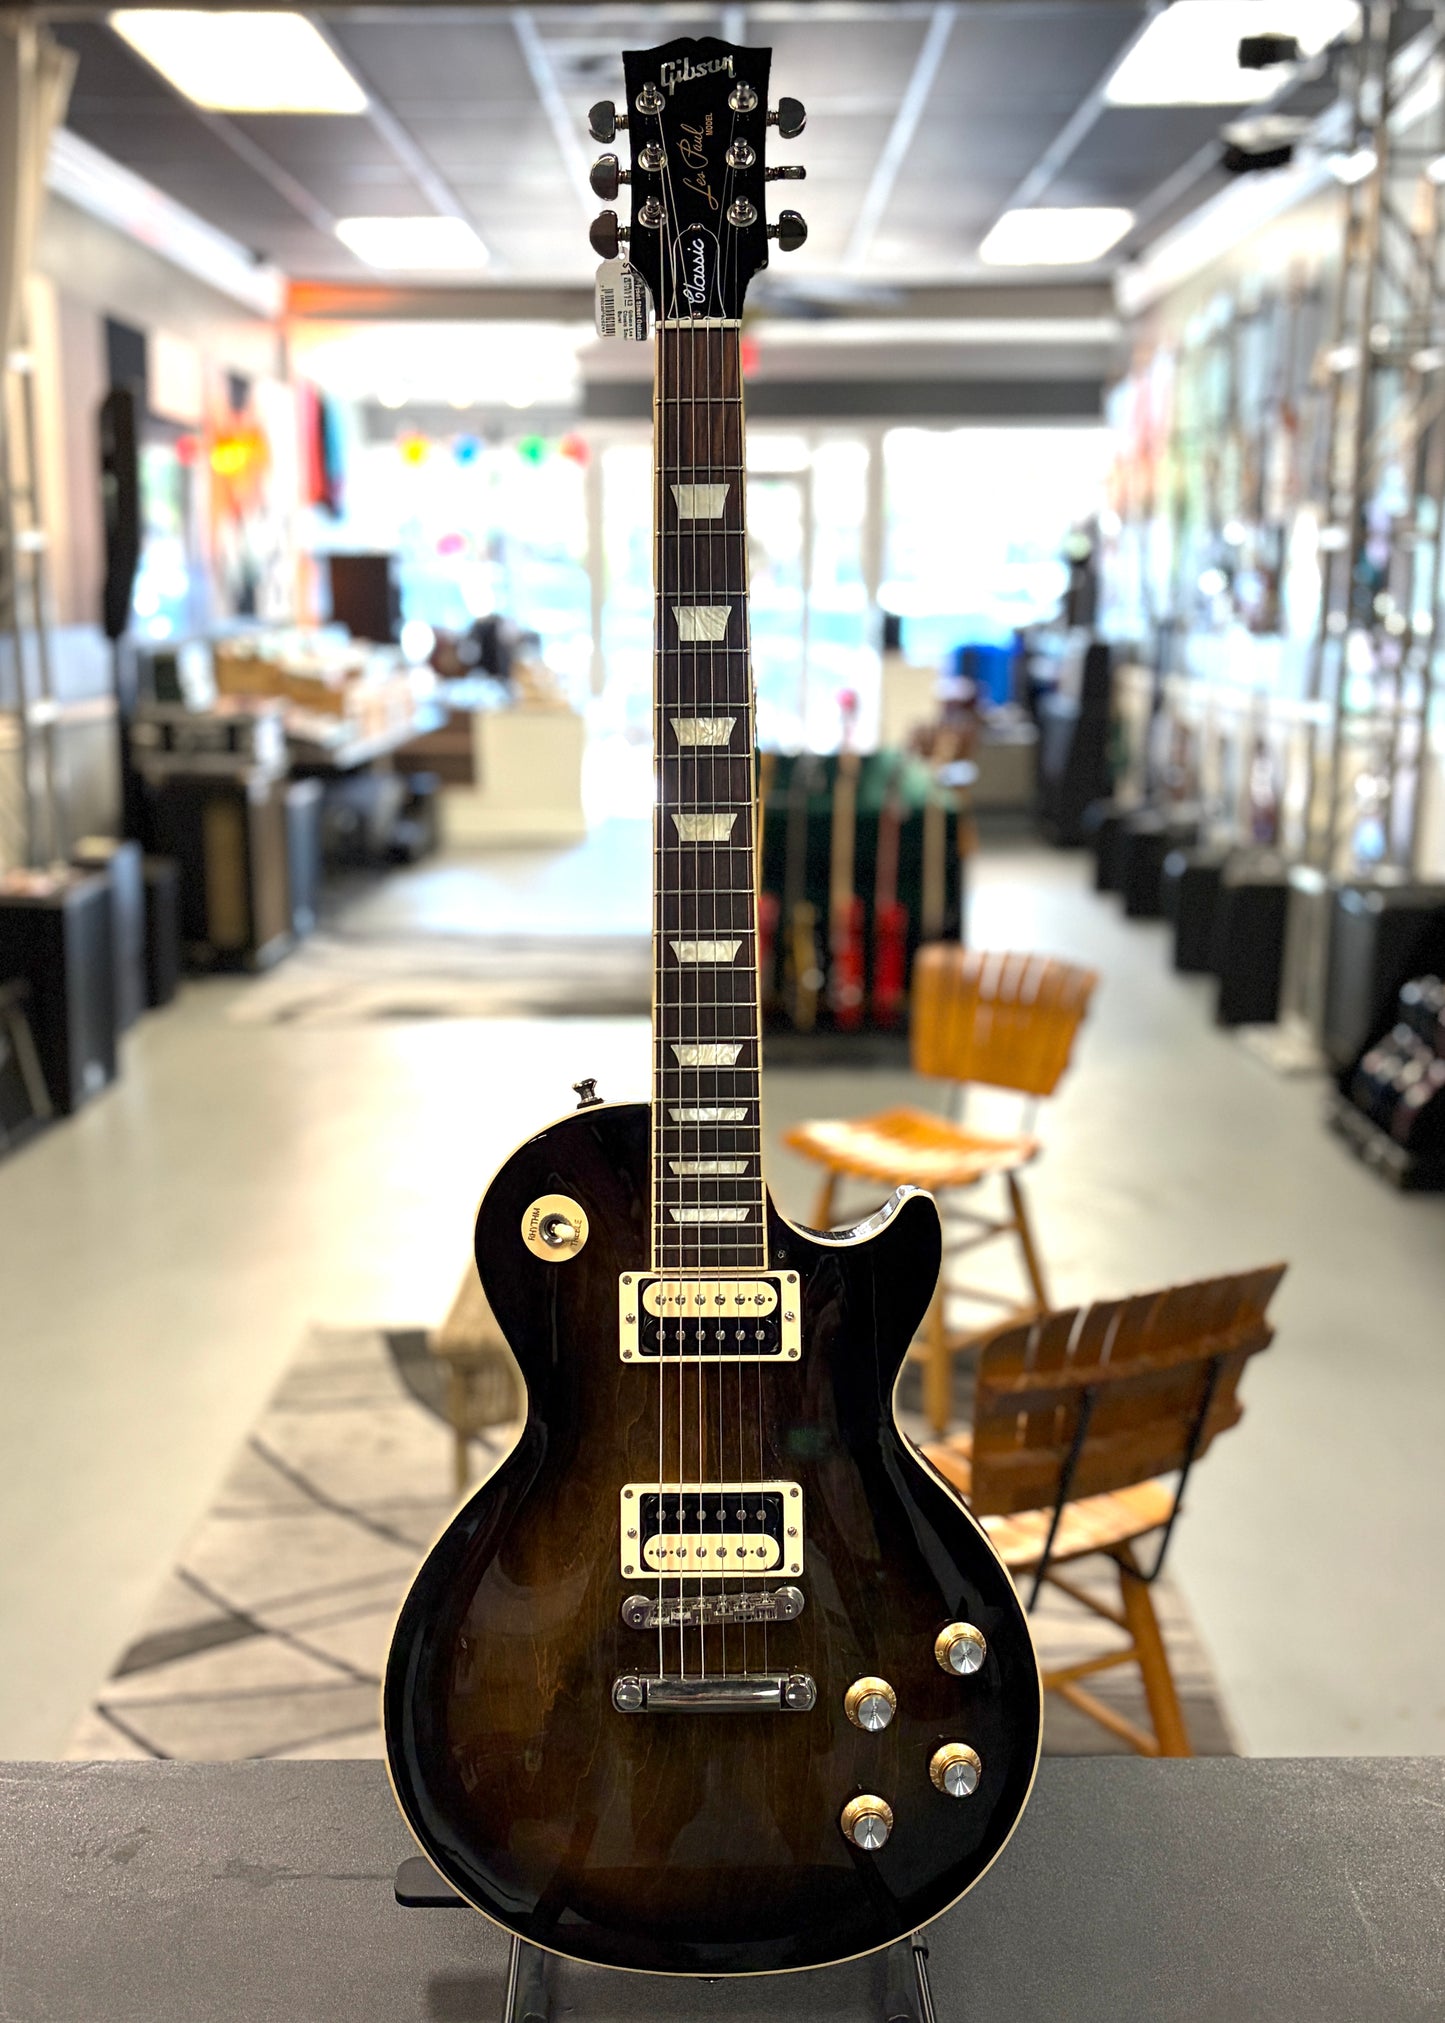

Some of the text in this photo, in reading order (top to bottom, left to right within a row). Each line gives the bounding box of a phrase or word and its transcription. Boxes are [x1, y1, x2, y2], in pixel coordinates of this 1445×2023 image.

[661, 55, 737, 96] Gibson
[705, 112, 713, 136] MODEL
[676, 123, 719, 211] Les Paul
[683, 238, 706, 304] Classic
[528, 1207, 541, 1241] RHYTHM
